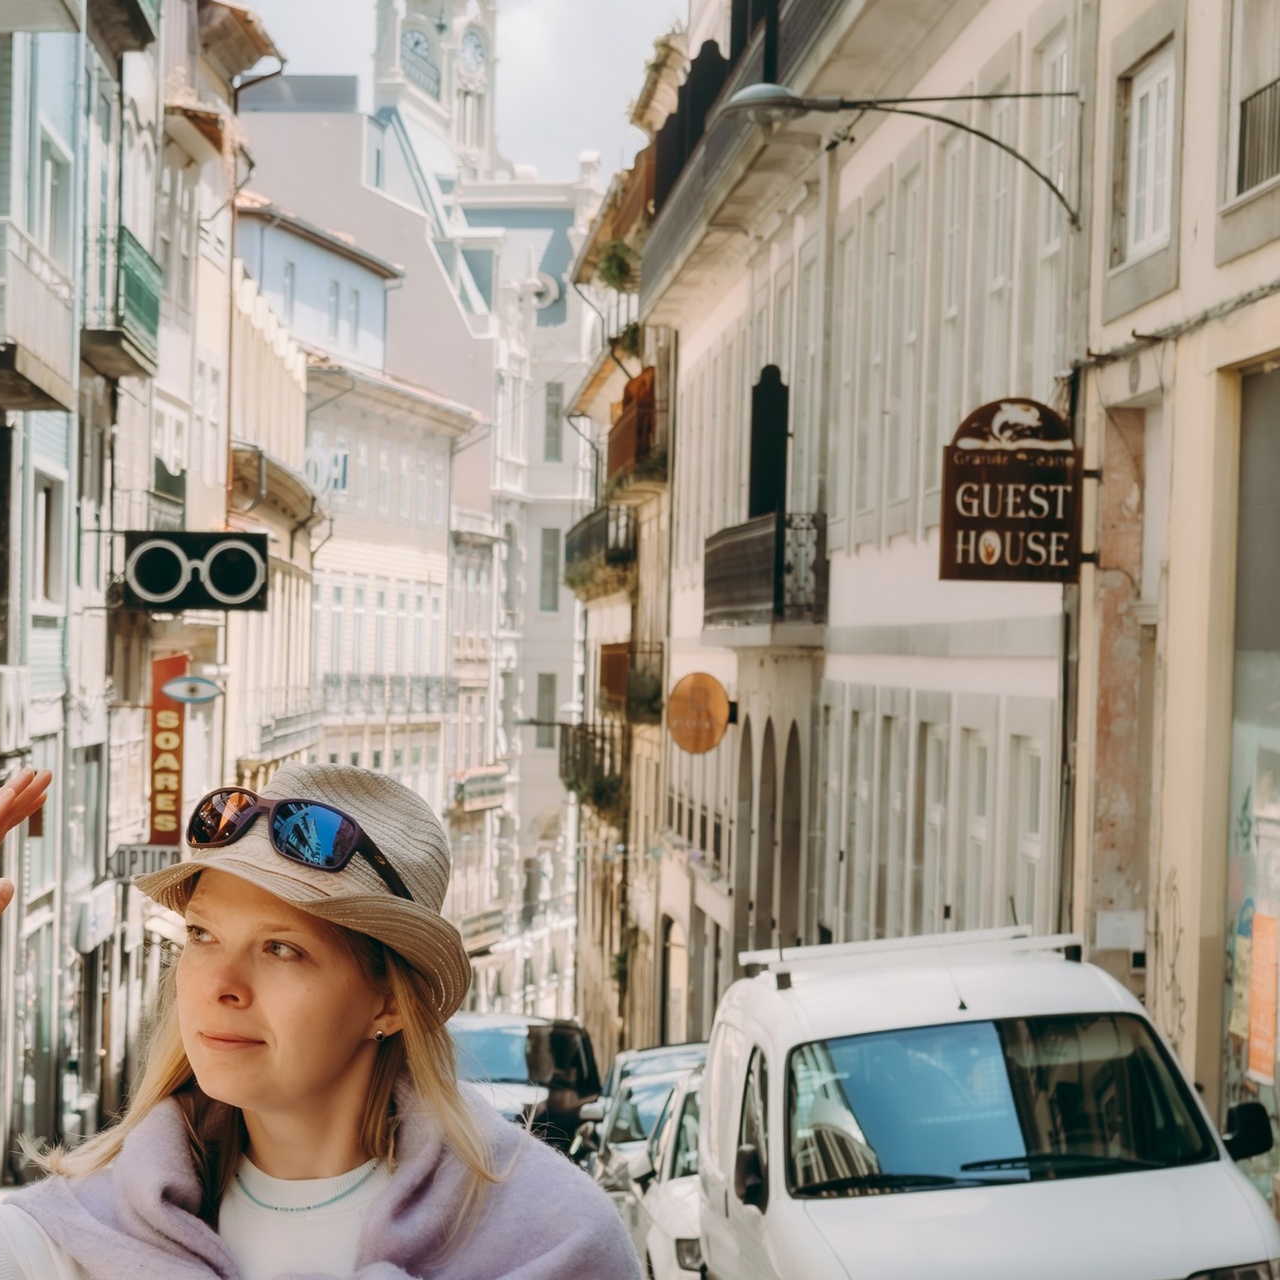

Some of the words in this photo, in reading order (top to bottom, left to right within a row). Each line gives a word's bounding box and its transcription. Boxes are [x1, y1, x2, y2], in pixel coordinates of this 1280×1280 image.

[955, 483, 1073, 519] GUEST
[955, 530, 1070, 567] HOUSE
[154, 710, 181, 832] SOARES
